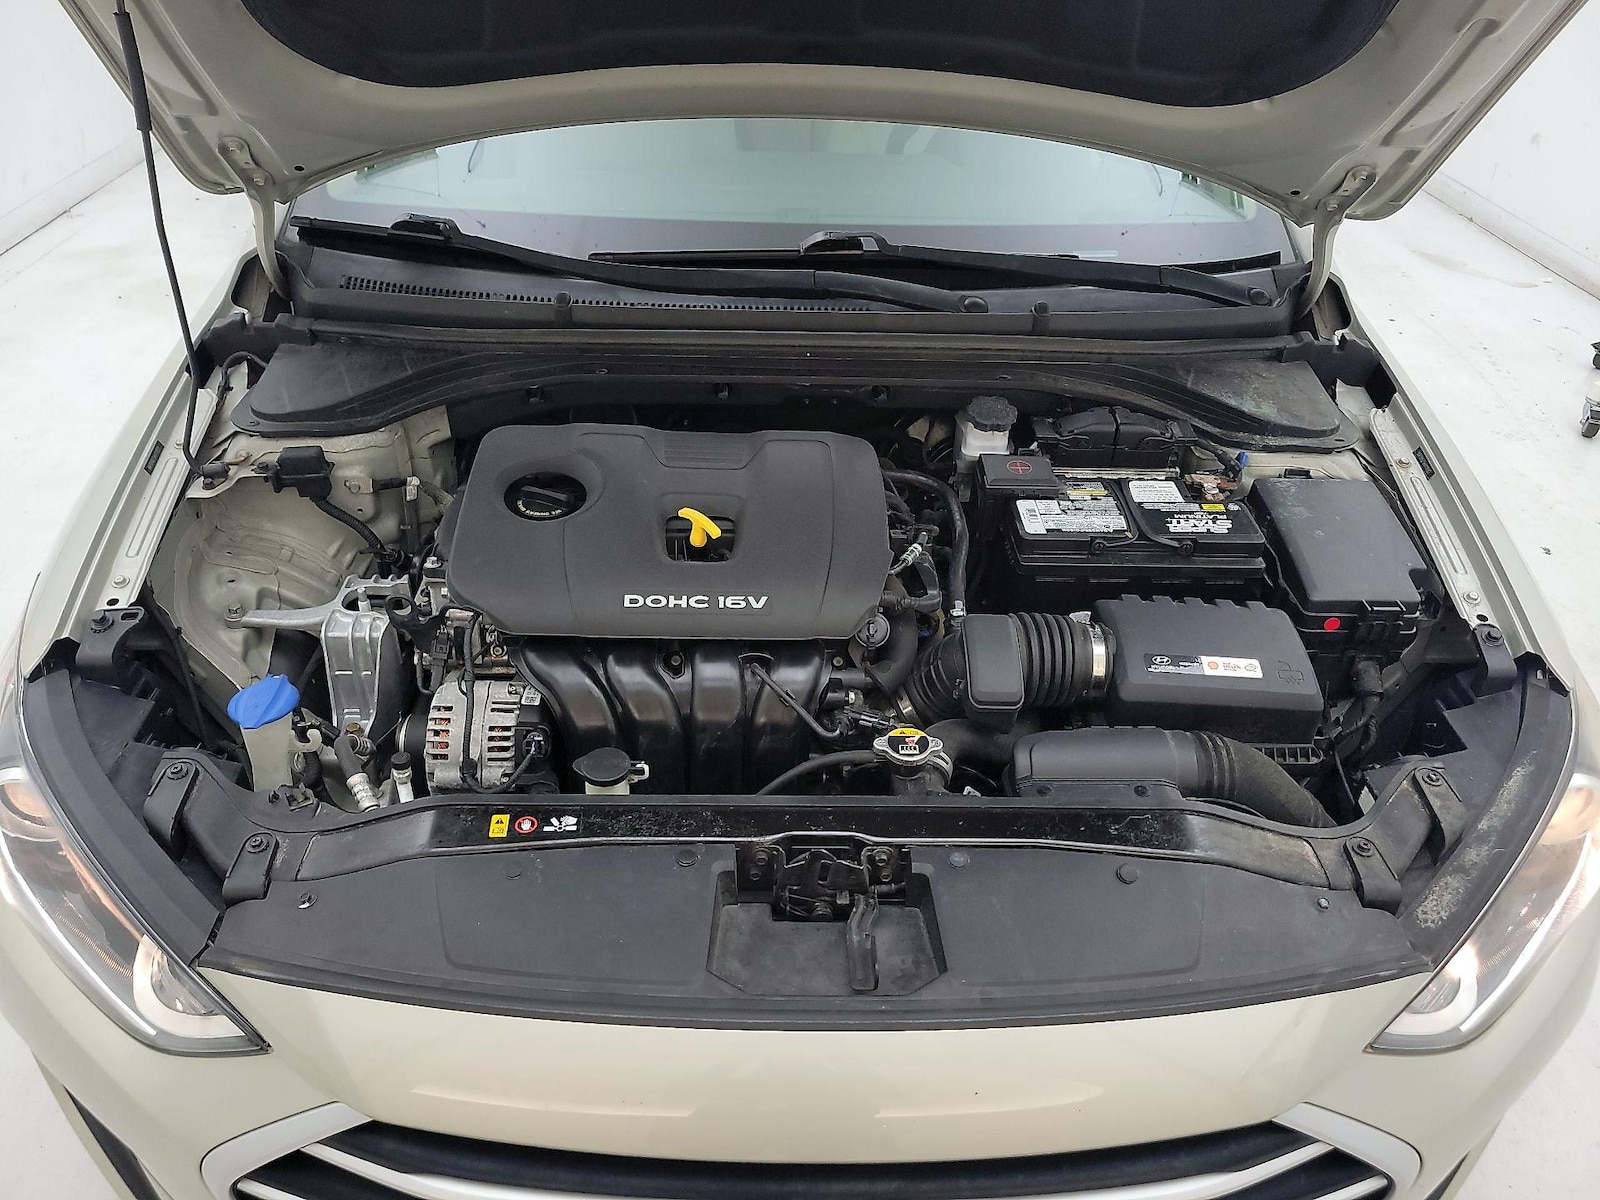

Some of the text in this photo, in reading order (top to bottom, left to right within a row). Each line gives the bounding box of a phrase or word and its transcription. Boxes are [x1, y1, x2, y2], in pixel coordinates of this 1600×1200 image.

[1165, 518, 1233, 528] START
[1169, 525, 1229, 533] SUPER
[623, 594, 769, 609] DOHC 16V
